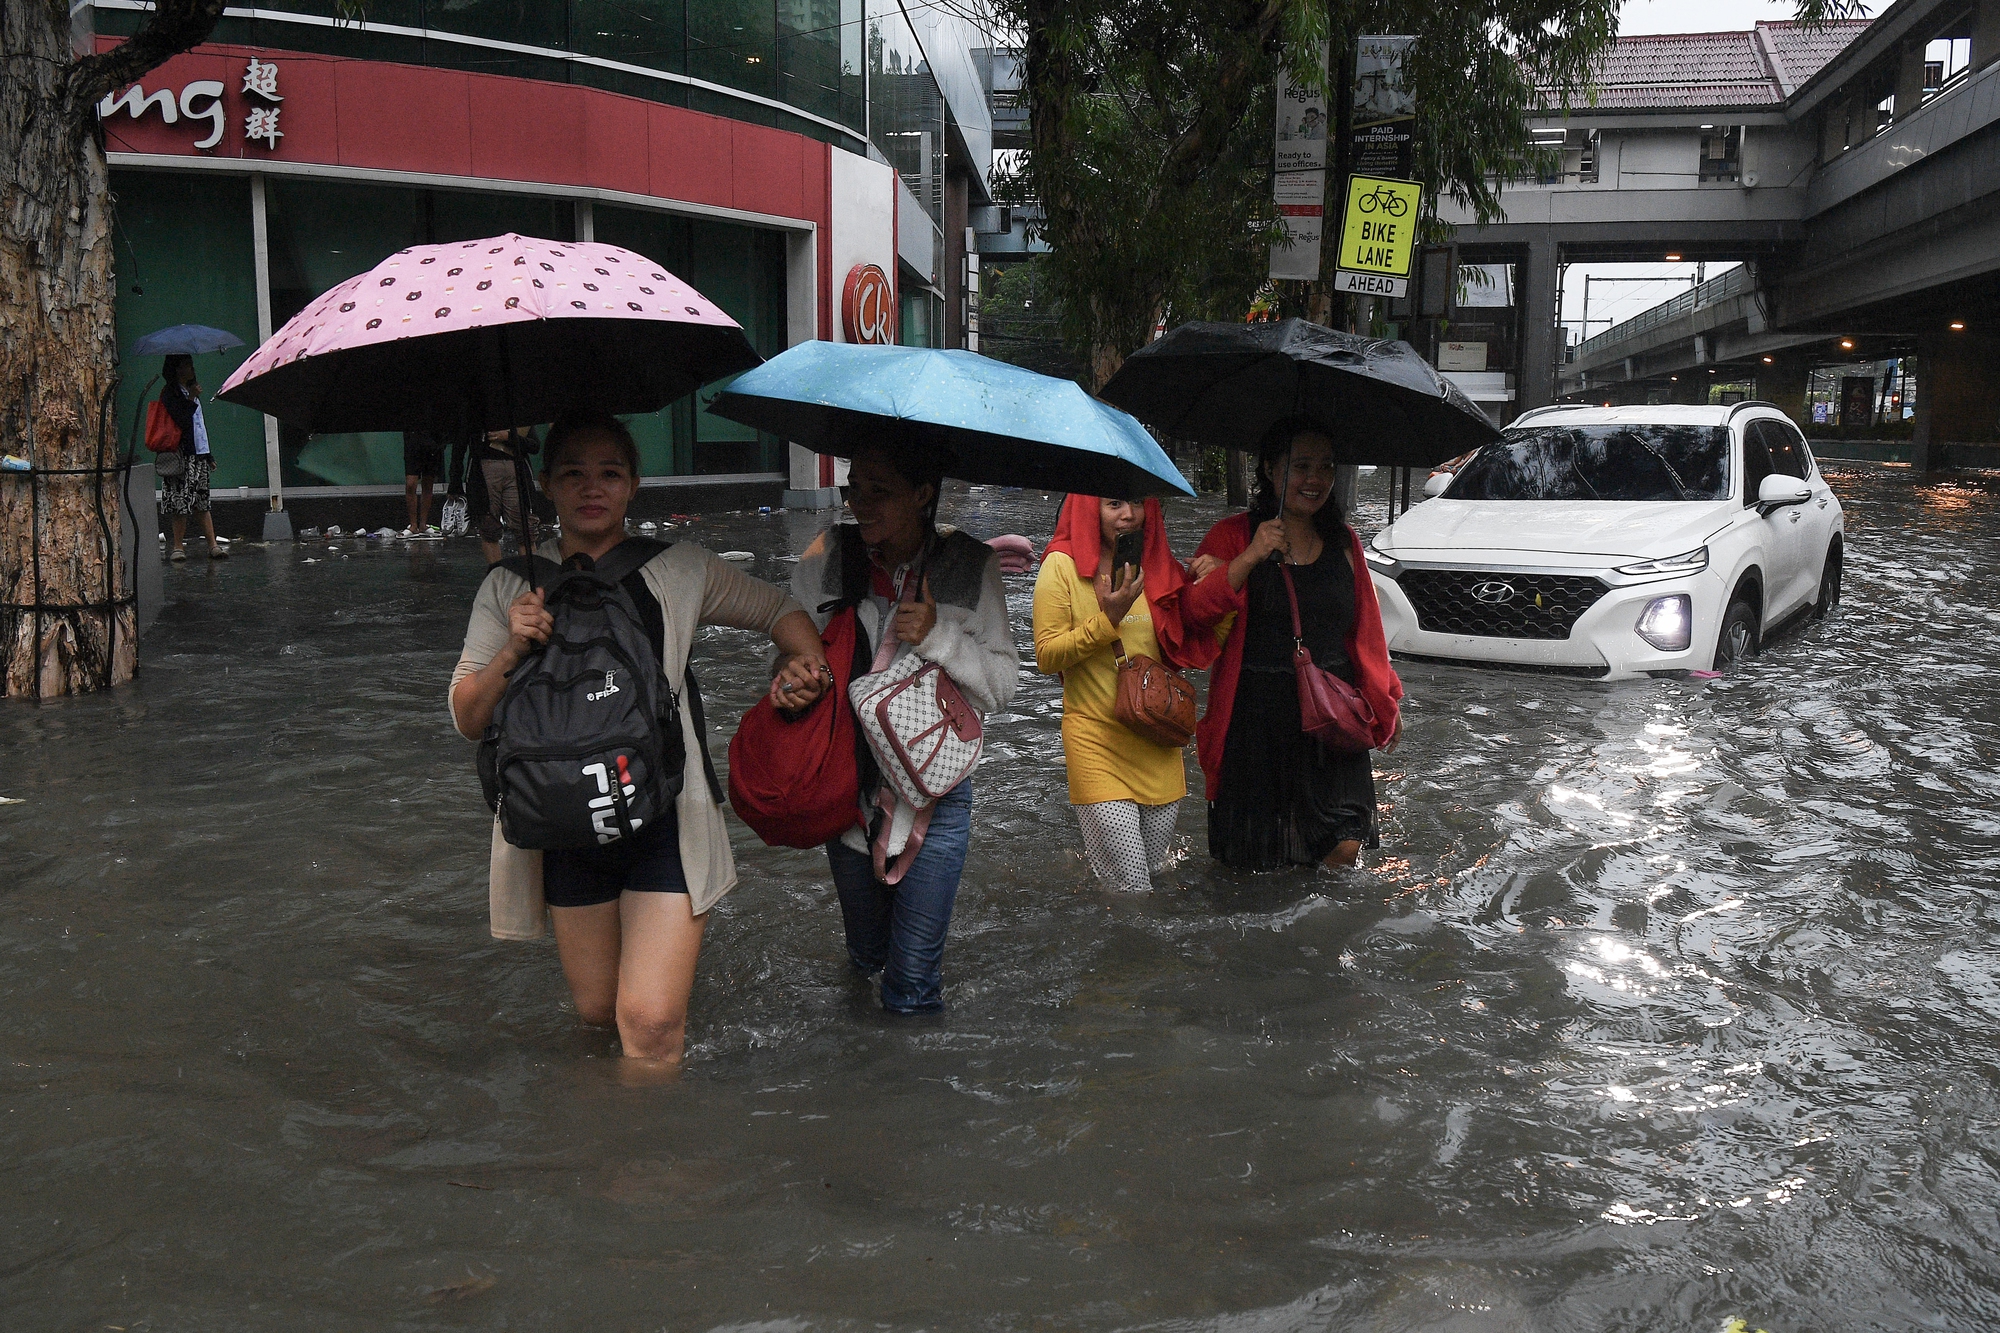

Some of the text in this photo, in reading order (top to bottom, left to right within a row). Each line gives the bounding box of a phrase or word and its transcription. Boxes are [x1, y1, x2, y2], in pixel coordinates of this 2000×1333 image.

[1284, 87, 1321, 103] Regus
[241, 56, 285, 150] 超群
[1371, 126, 1394, 134] PAID
[1354, 134, 1410, 143] INTERNSHIP
[1365, 142, 1398, 150] IN ASIA
[1278, 152, 1302, 161] Ready
[1292, 160, 1321, 168] offices.
[1361, 221, 1396, 243] BIKE
[1298, 233, 1319, 243] Regus
[1356, 245, 1394, 268] LANE
[1347, 275, 1394, 294] AHEAD
